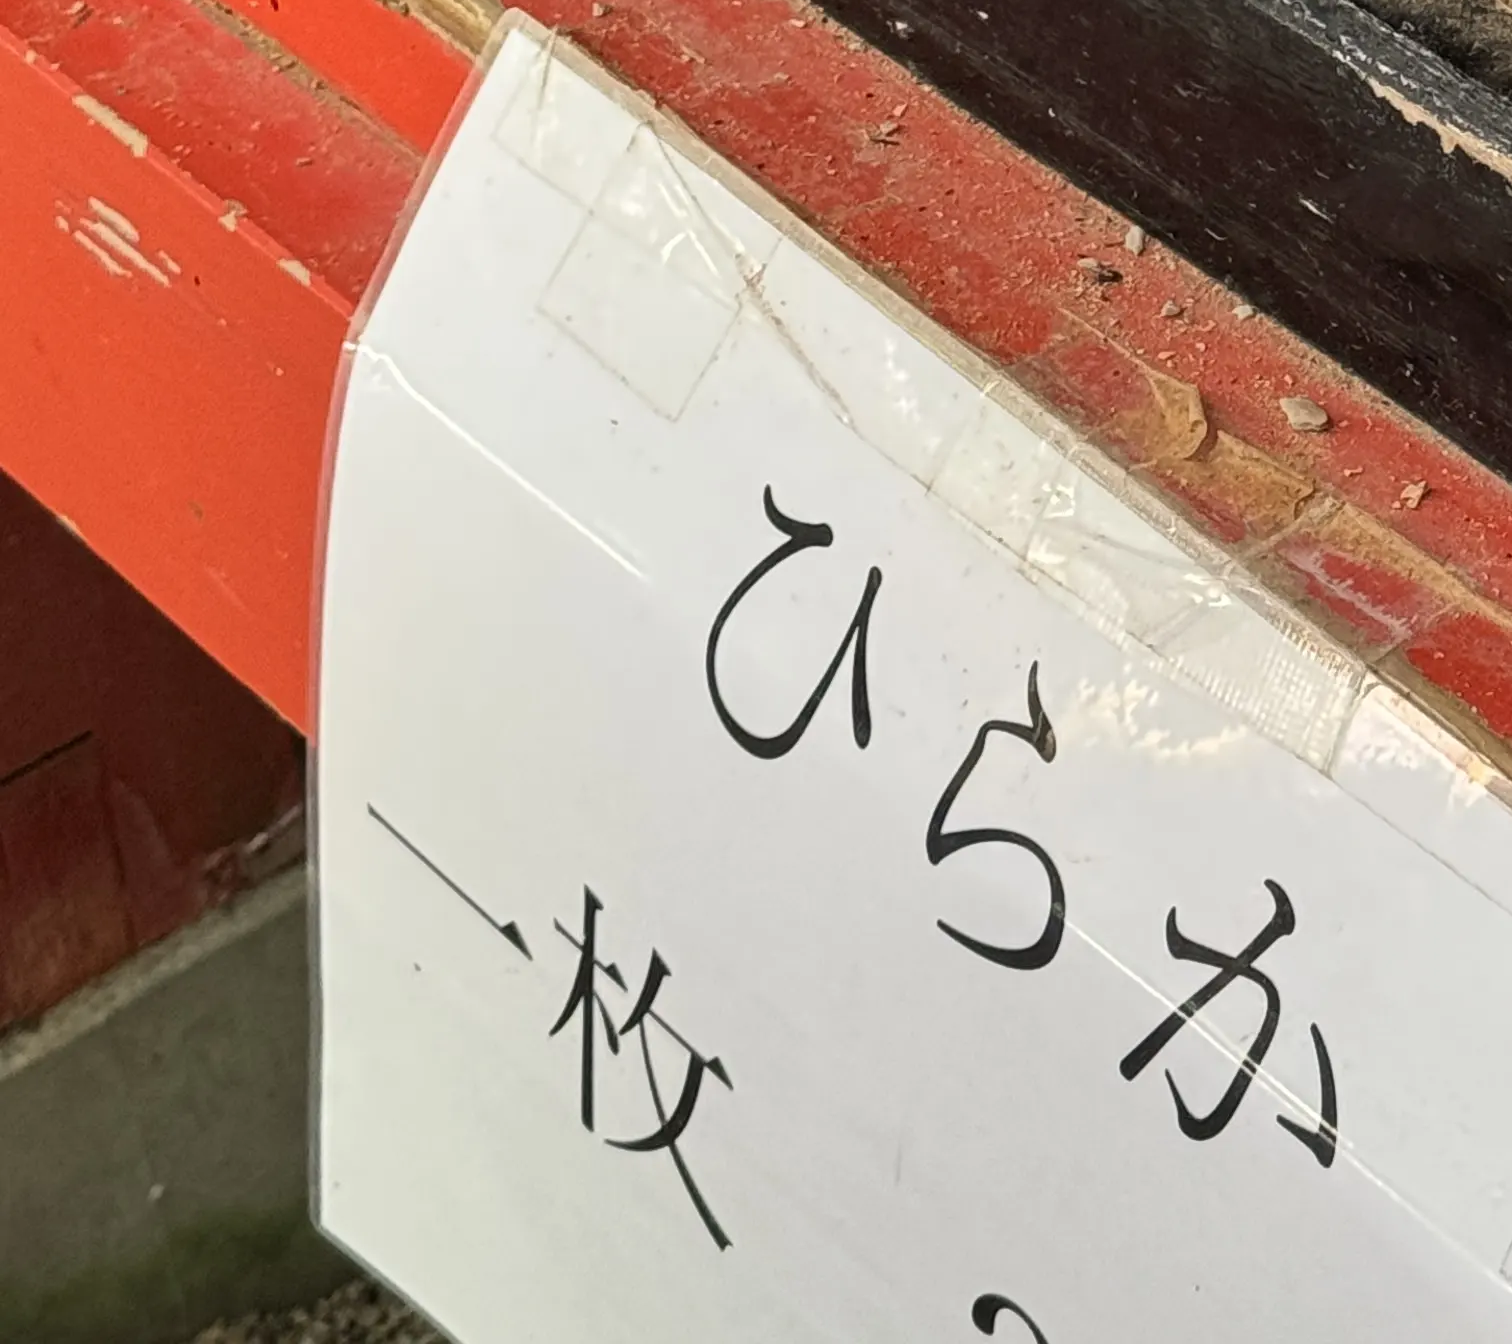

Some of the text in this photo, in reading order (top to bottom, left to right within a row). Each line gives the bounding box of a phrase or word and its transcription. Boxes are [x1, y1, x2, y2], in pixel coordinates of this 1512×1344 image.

[366, 803, 735, 1250] 一枚
[706, 484, 1338, 1168] ひらか
